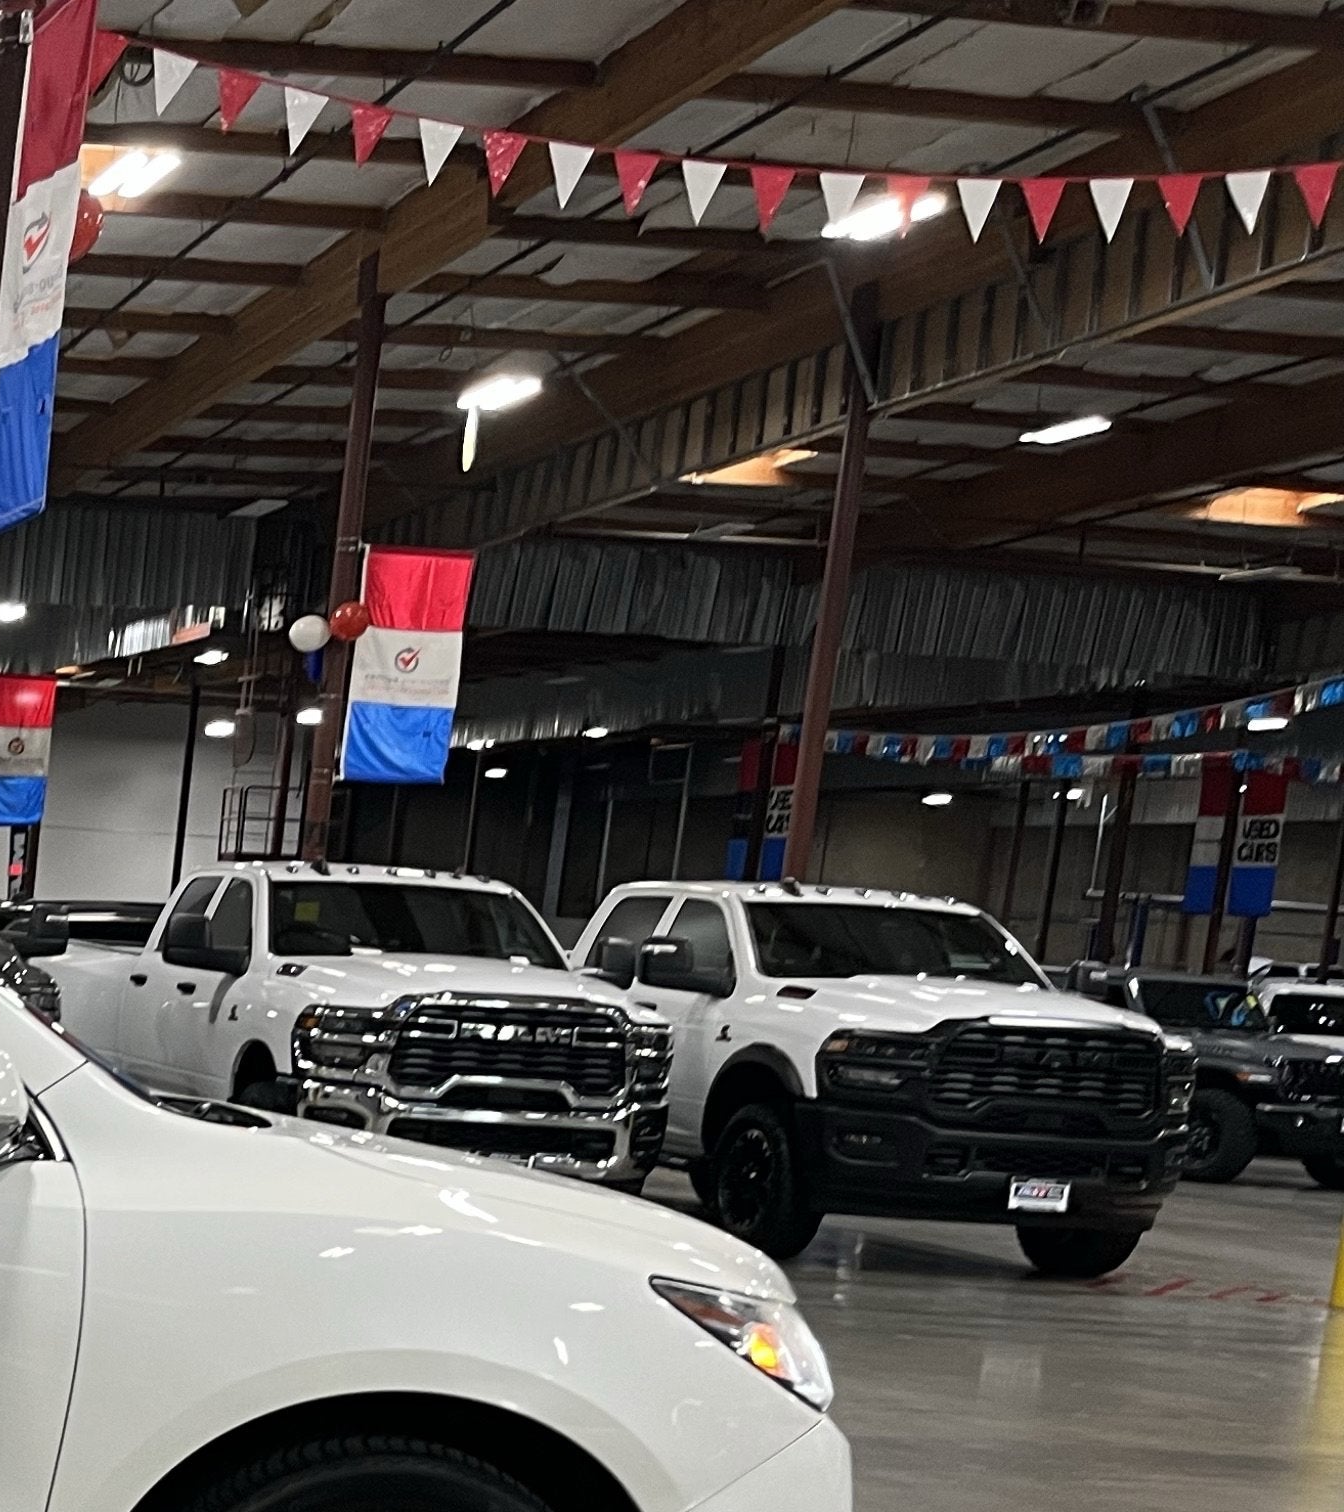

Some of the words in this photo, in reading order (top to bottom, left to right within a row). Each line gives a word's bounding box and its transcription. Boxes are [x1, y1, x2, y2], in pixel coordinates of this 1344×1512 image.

[1242, 819, 1280, 839] USED
[1237, 842, 1278, 863] CARS
[461, 1022, 572, 1044] RAM
